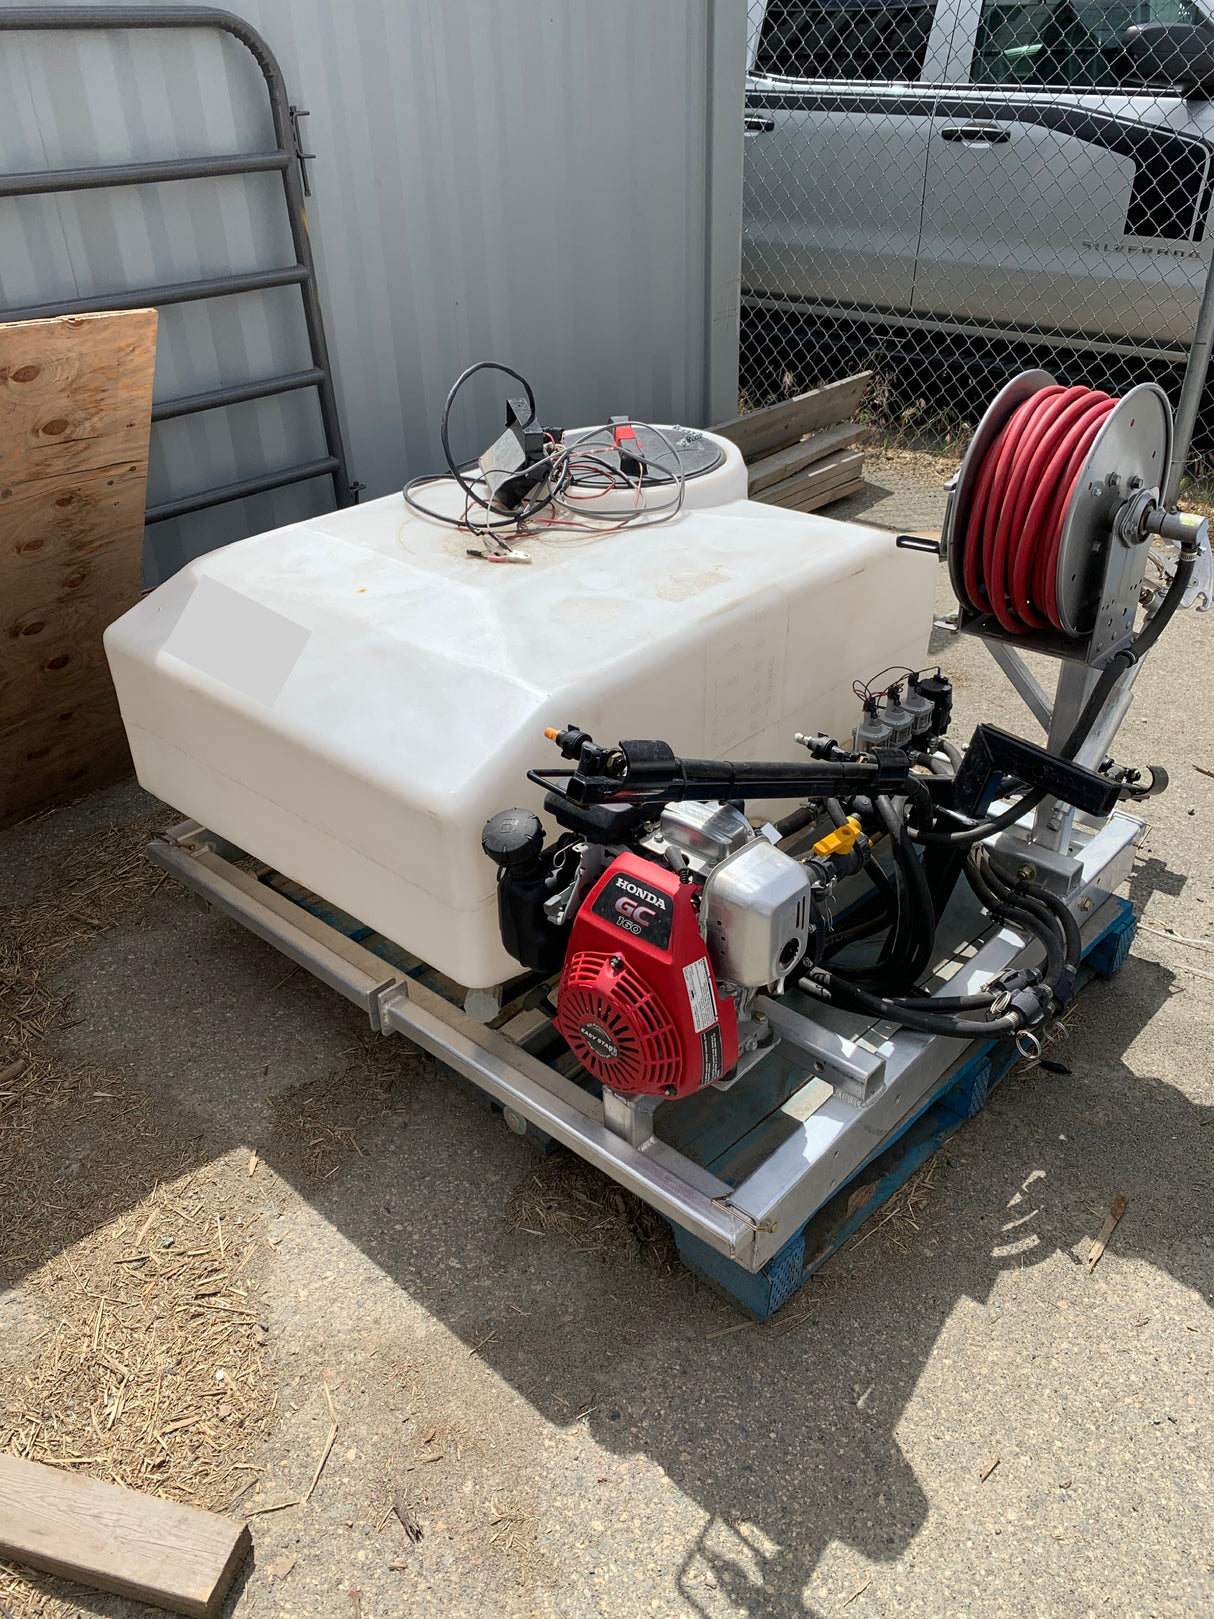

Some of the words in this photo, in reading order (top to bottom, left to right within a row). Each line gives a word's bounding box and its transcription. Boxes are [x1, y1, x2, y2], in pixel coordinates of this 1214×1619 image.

[1082, 240, 1200, 258] SILVERADO
[615, 877, 666, 910] HONDA
[614, 896, 656, 927] GC
[616, 915, 642, 935] 160
[580, 1027, 597, 1040] EASY
